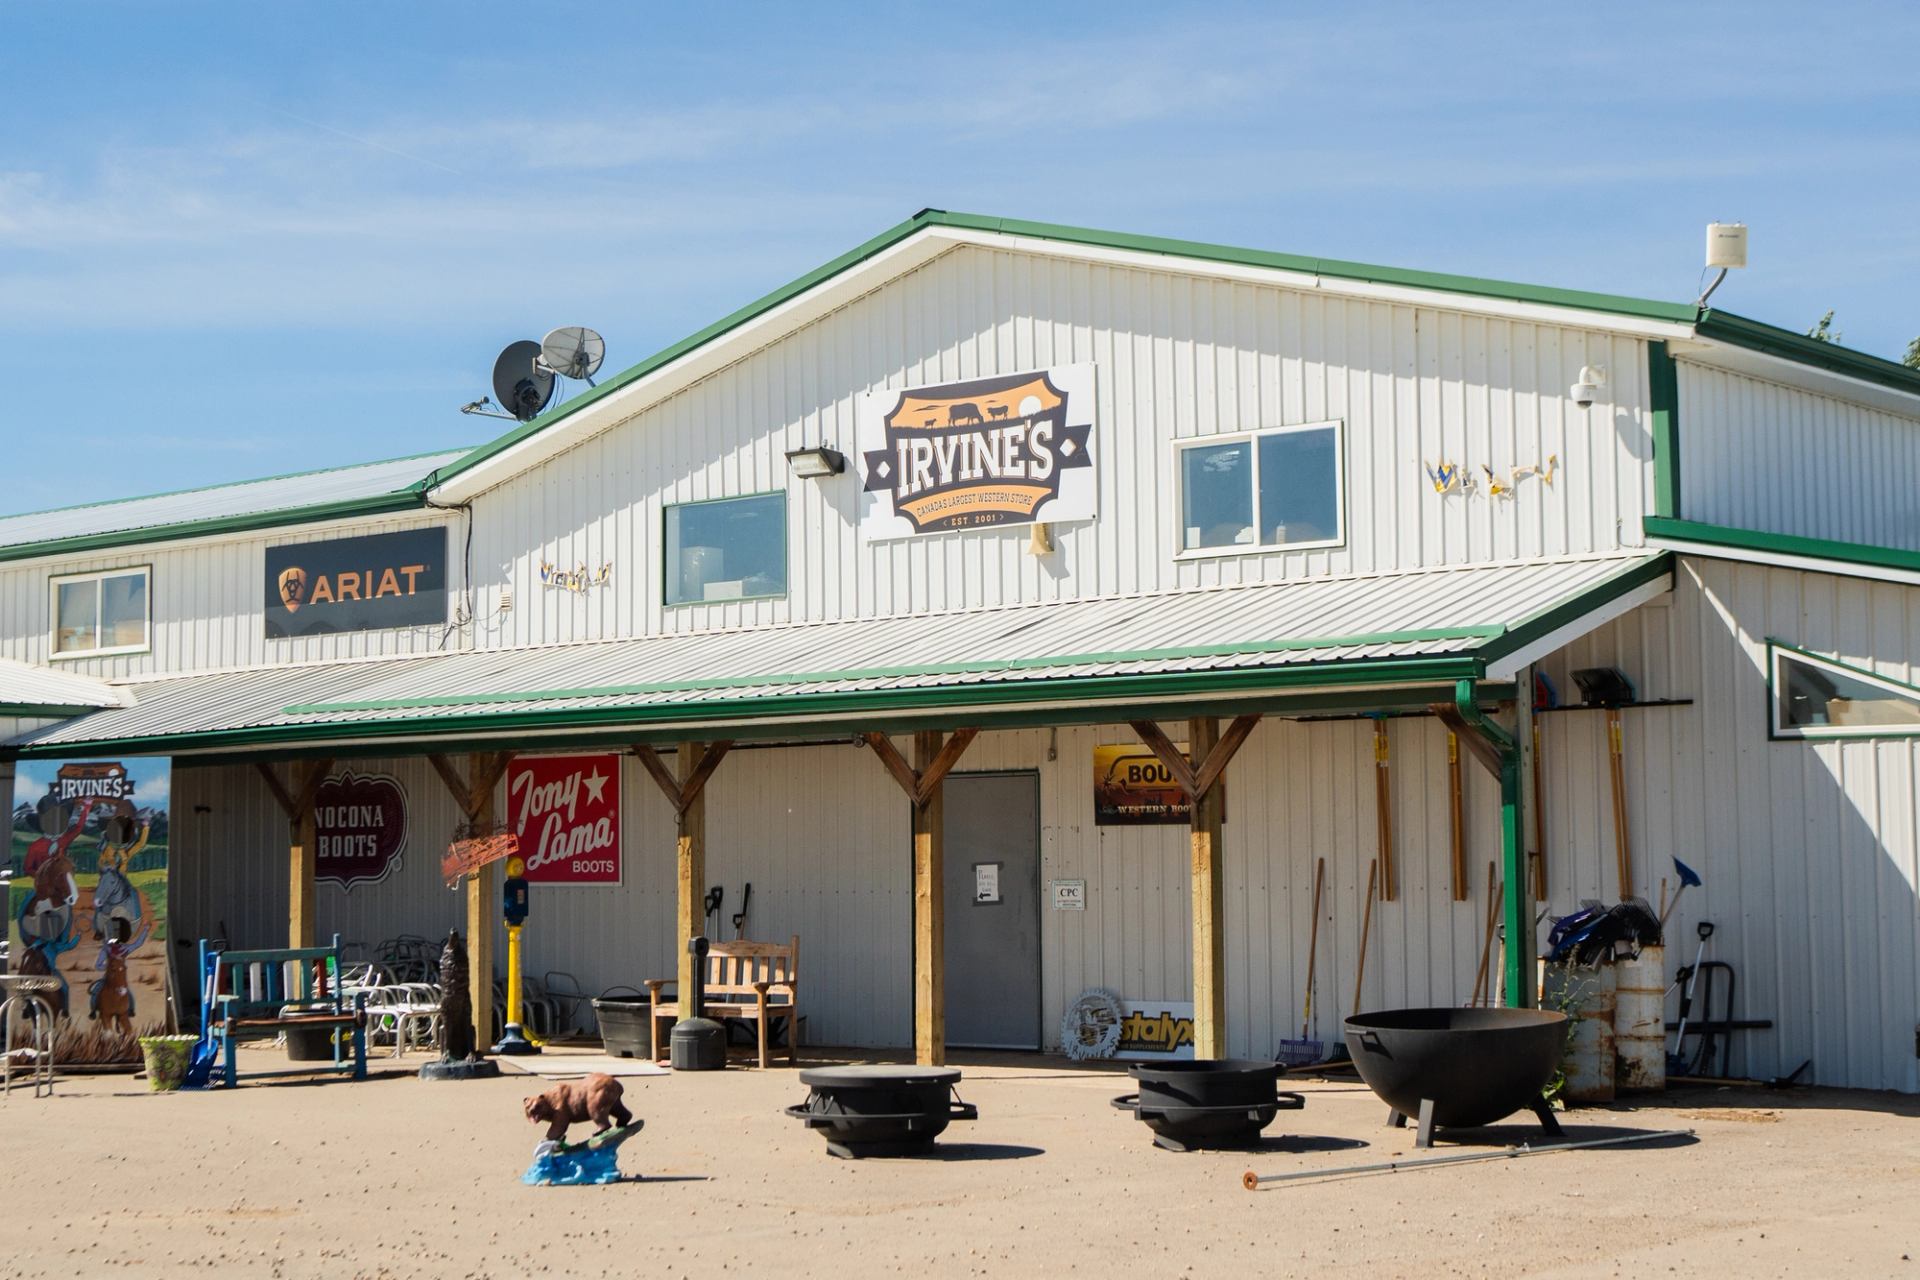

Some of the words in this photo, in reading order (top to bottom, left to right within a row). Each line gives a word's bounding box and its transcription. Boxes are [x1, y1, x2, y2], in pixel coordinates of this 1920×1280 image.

[896, 418, 1054, 501] IRVINE'S
[948, 493, 976, 508] LARGEST
[978, 491, 1010, 505] WESTERN
[1010, 493, 1033, 506] STORE
[975, 514, 996, 524] 2001
[310, 565, 425, 605] ARIAT
[61, 777, 123, 801] IRVINE'S
[511, 769, 583, 838] Tony
[1117, 804, 1167, 815] WESTERN
[317, 834, 378, 858] BOOTS
[526, 811, 615, 872] Lama
[572, 859, 615, 874] BOOTS
[1060, 887, 1079, 897] CPC
